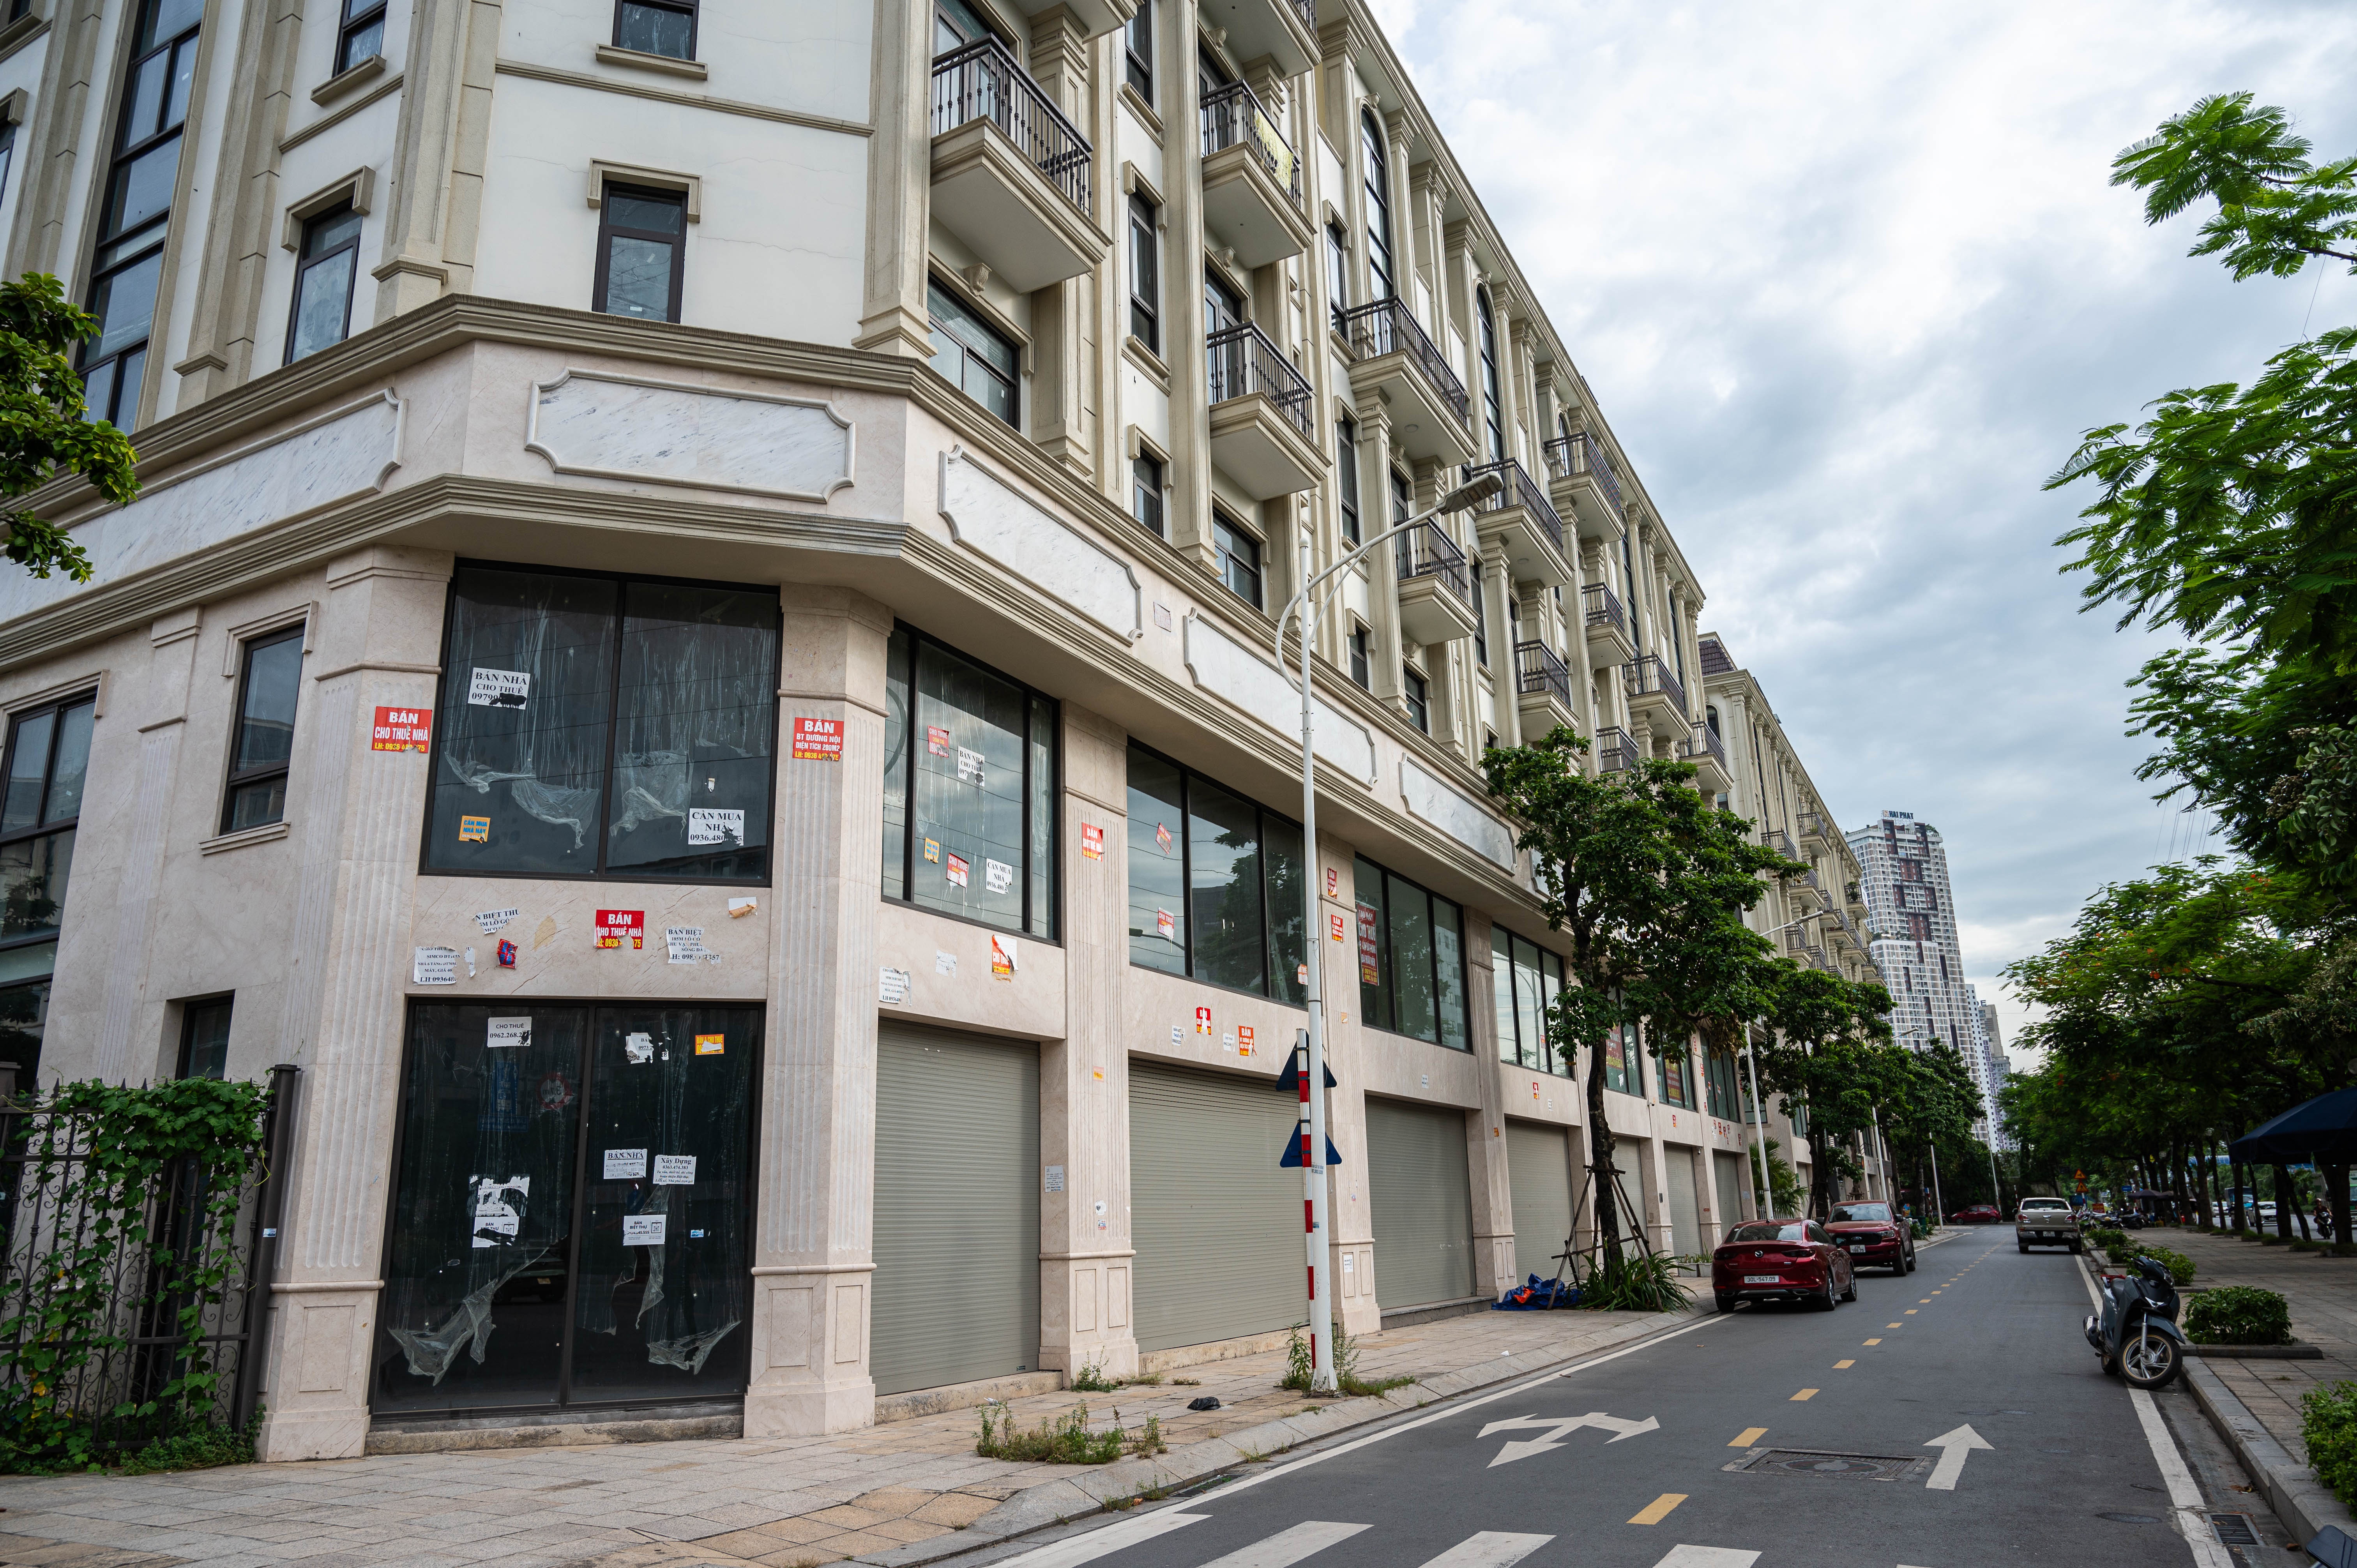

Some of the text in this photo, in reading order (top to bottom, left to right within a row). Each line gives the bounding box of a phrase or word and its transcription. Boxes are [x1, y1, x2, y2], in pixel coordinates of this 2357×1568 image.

[475, 671, 527, 685] BÁN NHÀ
[499, 686, 523, 694] THUÊ
[389, 710, 418, 724] BÁN
[804, 720, 834, 733] BÁN
[375, 726, 390, 739] CHO
[412, 727, 428, 741] NHÀ
[938, 730, 947, 739] THUÊ
[829, 735, 841, 744] NỘI
[796, 741, 808, 750] DIỆN
[809, 742, 821, 750] TÍCH
[960, 750, 971, 760] BÁN
[961, 760, 970, 768] CHO
[692, 810, 714, 819] CẦN
[1087, 828, 1097, 839] BÁN
[988, 861, 1011, 874] CẦN MUA
[994, 873, 1004, 882] NHÀ
[608, 912, 631, 924] BÁN
[611, 926, 627, 936] THUÊ
[629, 926, 641, 937] NHÀ
[605, 939, 618, 947] 0936
[1241, 1027, 1251, 1037] BÁN
